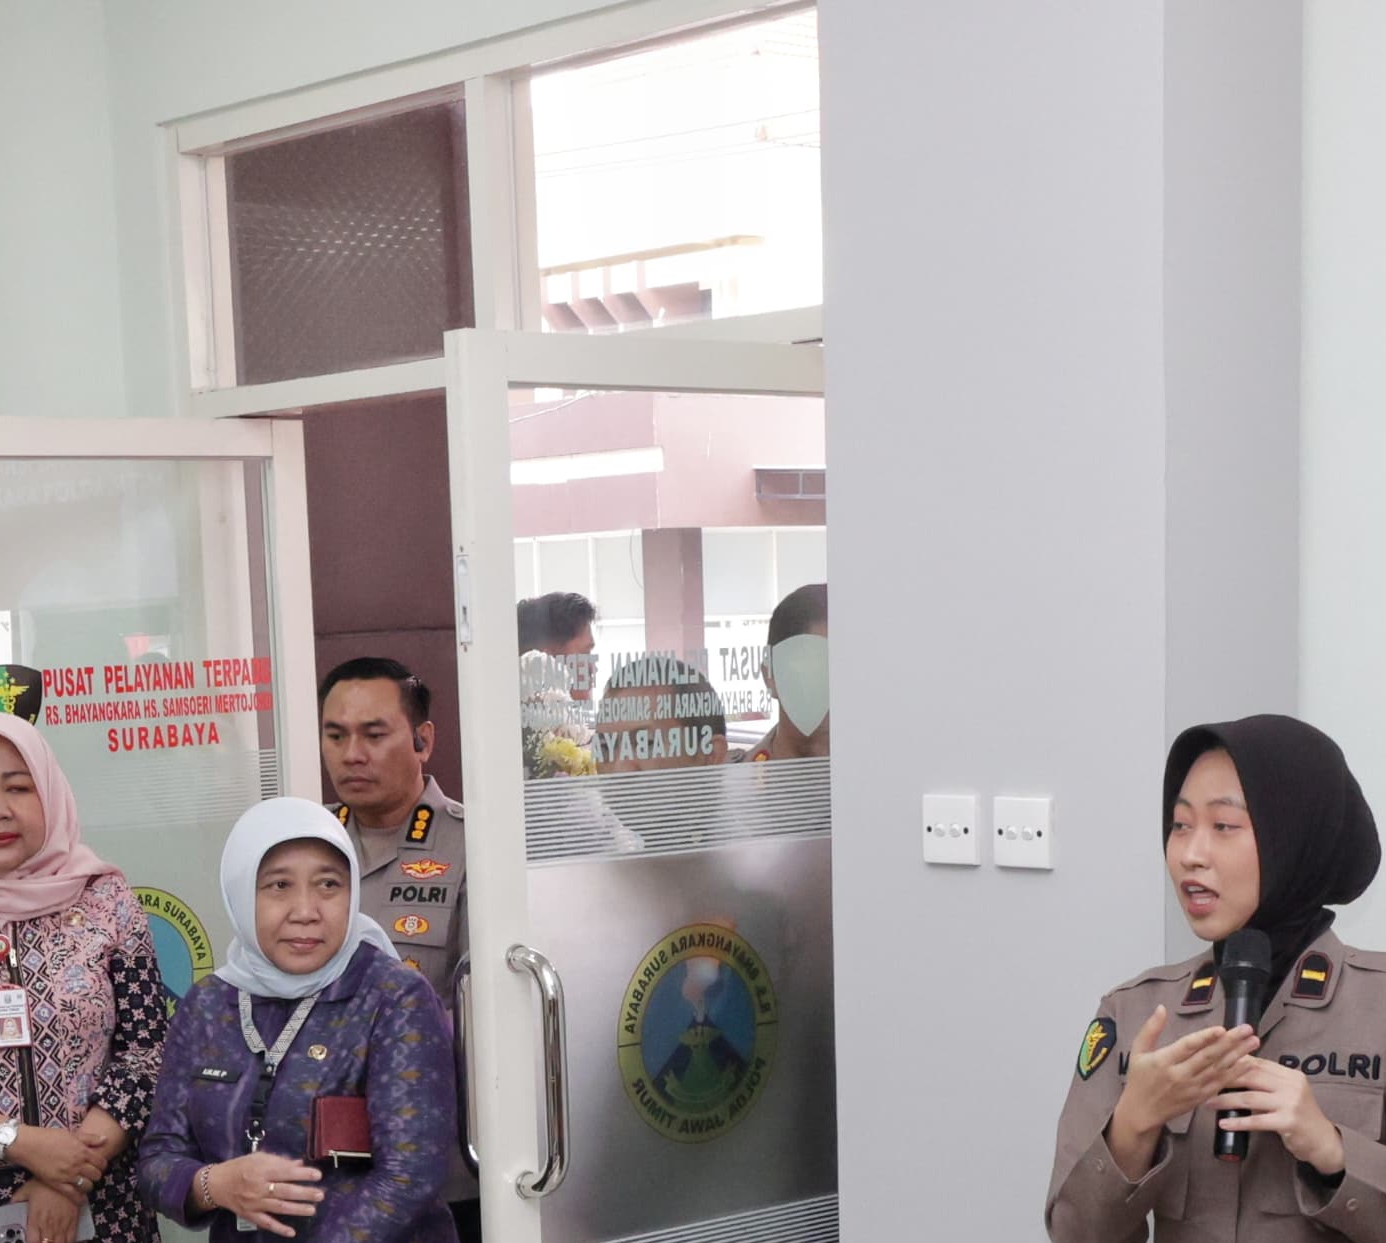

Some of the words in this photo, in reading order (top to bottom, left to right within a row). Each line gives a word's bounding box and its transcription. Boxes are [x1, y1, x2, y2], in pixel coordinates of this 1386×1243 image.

[42, 666, 94, 698] PUSAT
[104, 661, 195, 694] PELAYANAN
[45, 704, 63, 726] RS.
[65, 699, 141, 725] BHAYANGKARA
[144, 698, 161, 720] HS.
[163, 695, 213, 718] SAMSOERI
[108, 721, 221, 752] SURABAYA
[389, 886, 448, 904] POLRI
[163, 900, 207, 961] SURABAYA
[1278, 1051, 1381, 1081] POLRI
